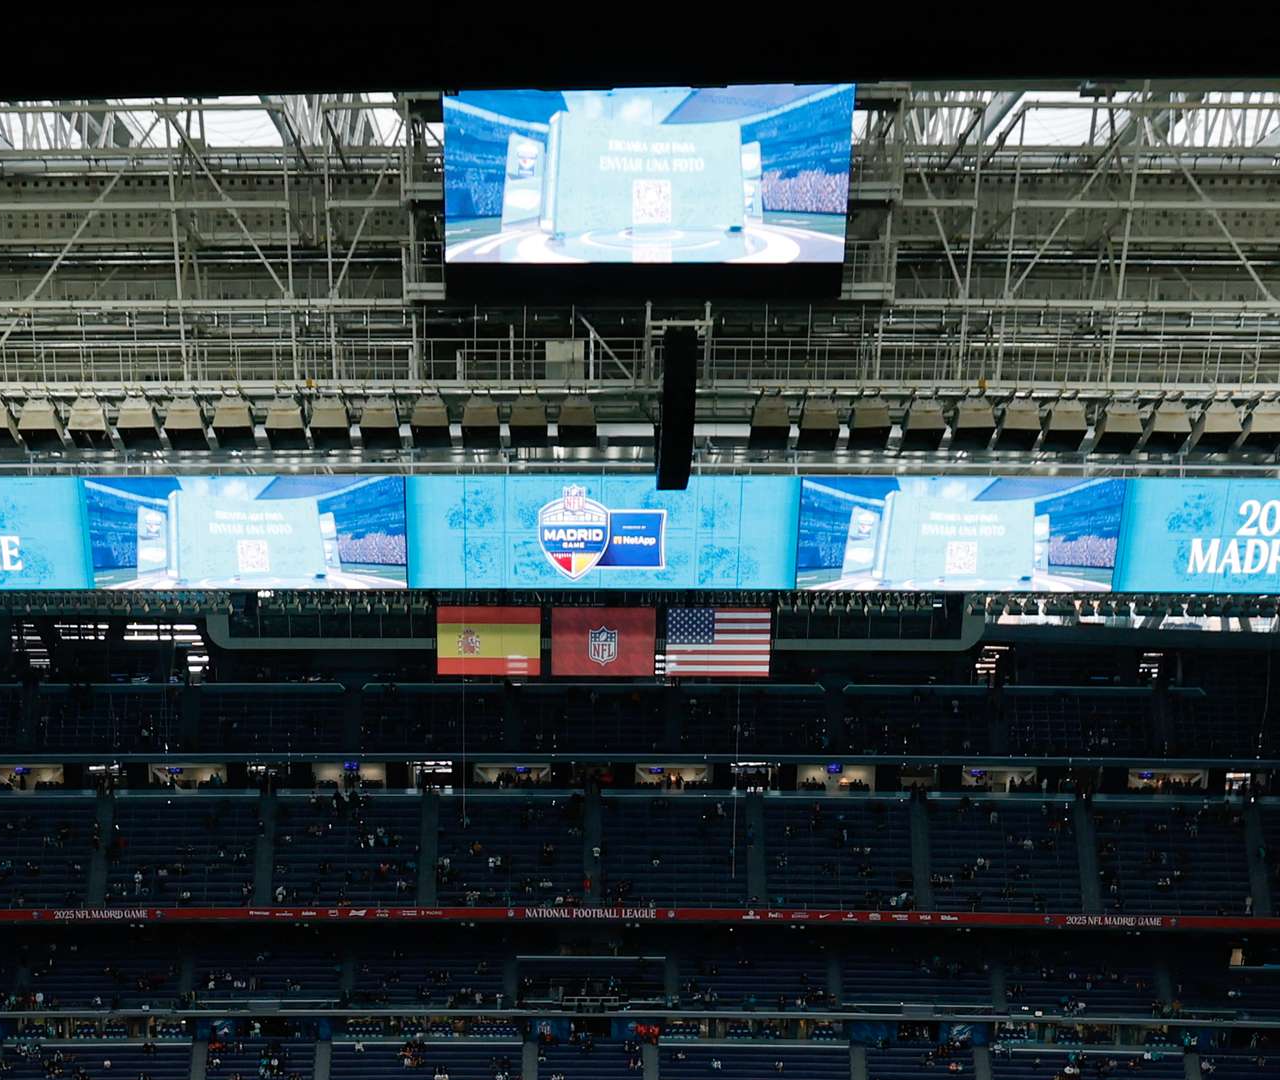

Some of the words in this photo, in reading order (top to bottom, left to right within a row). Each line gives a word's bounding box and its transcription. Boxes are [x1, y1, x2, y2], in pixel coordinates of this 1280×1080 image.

[544, 528, 604, 542] MADRID
[623, 536, 656, 547] NetApp
[592, 642, 614, 658] NFL
[54, 910, 75, 919] 2025
[75, 910, 91, 919] NFL
[91, 910, 124, 920] MADRID
[124, 910, 148, 919] GAME
[525, 909, 570, 919] NATIONAL
[573, 909, 620, 919] FOOTBALL
[622, 909, 656, 919] LEAGUE
[1066, 916, 1087, 925] 2025
[1088, 917, 1102, 925] NFL
[1103, 917, 1136, 926] MADRID
[1138, 917, 1162, 926] GAME
